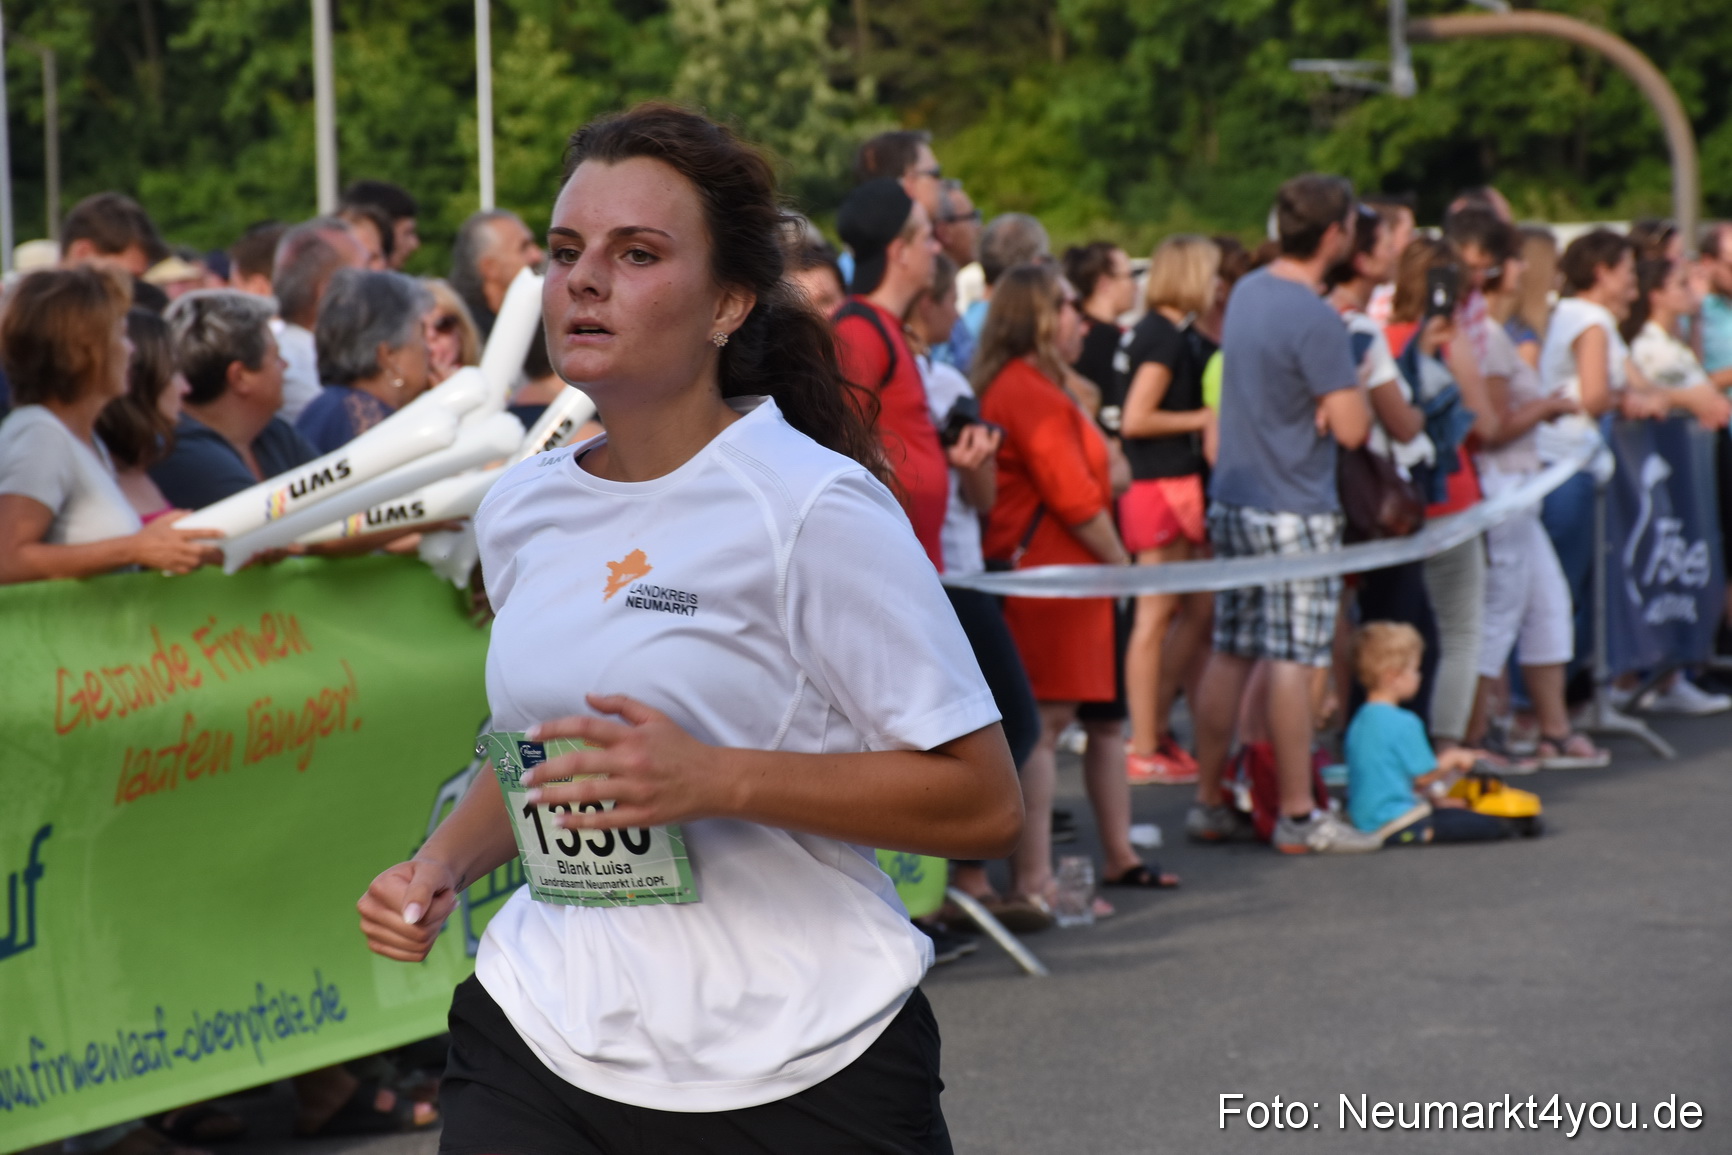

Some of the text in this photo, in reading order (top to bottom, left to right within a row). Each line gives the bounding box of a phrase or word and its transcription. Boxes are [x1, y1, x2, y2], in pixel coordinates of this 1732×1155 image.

[629, 583, 699, 605] LANDKREIS
[625, 595, 699, 617] NEUMARKT
[55, 612, 313, 735] Gesunde Firmen
[114, 711, 234, 806] laufen
[557, 860, 632, 876] Blank Luisa
[539, 875, 585, 889] Landratsamt
[586, 878, 630, 890] Neumarkt
